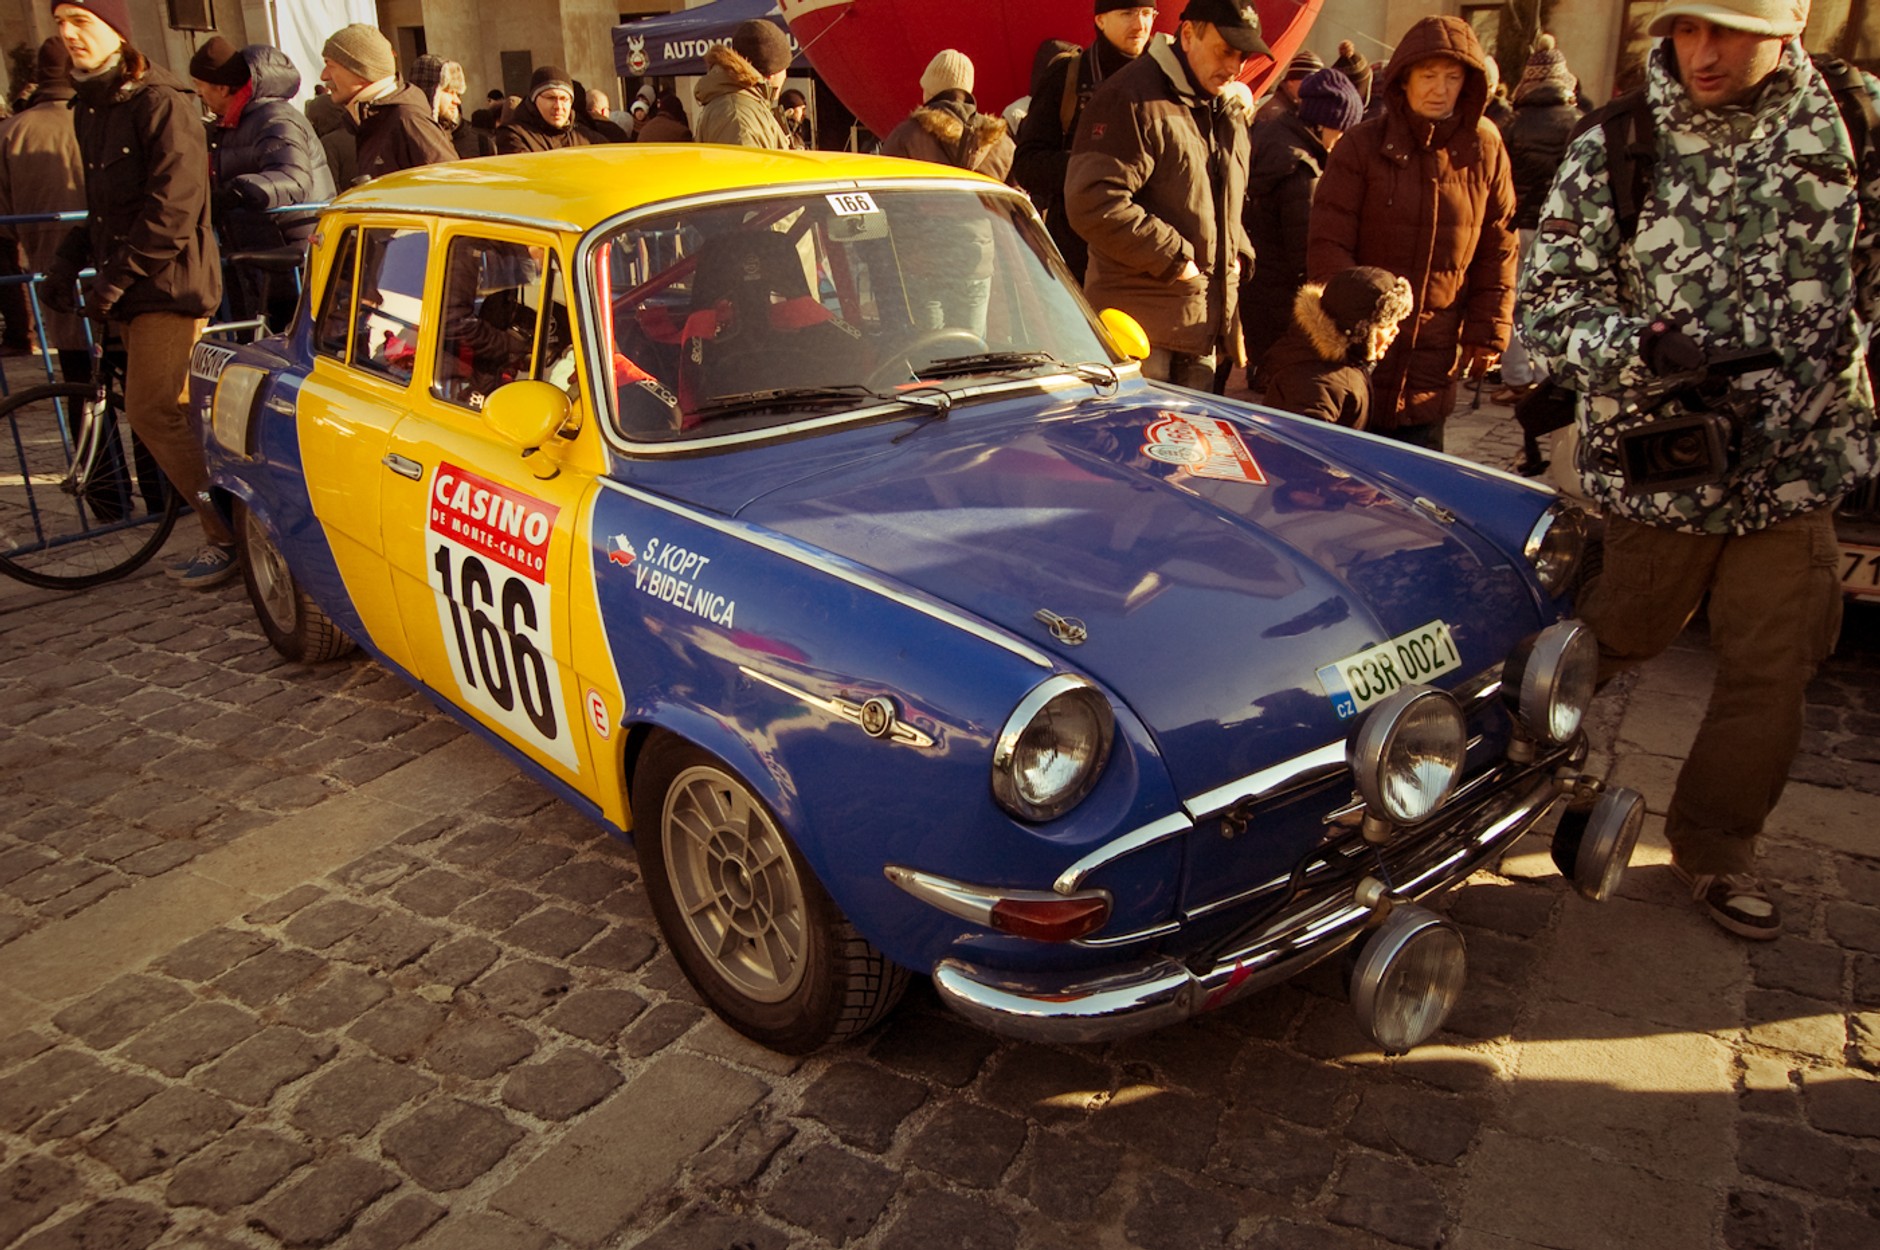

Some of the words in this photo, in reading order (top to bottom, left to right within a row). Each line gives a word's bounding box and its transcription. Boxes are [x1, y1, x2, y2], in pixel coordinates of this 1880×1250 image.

[835, 195, 870, 212] 166
[435, 473, 549, 547] CASINO
[432, 508, 447, 527] DE
[451, 518, 544, 571] MONTE-CARLO
[434, 543, 558, 741] 166
[1397, 627, 1456, 680] 0021
[591, 699, 606, 731] E
[1336, 699, 1356, 719] CZ
